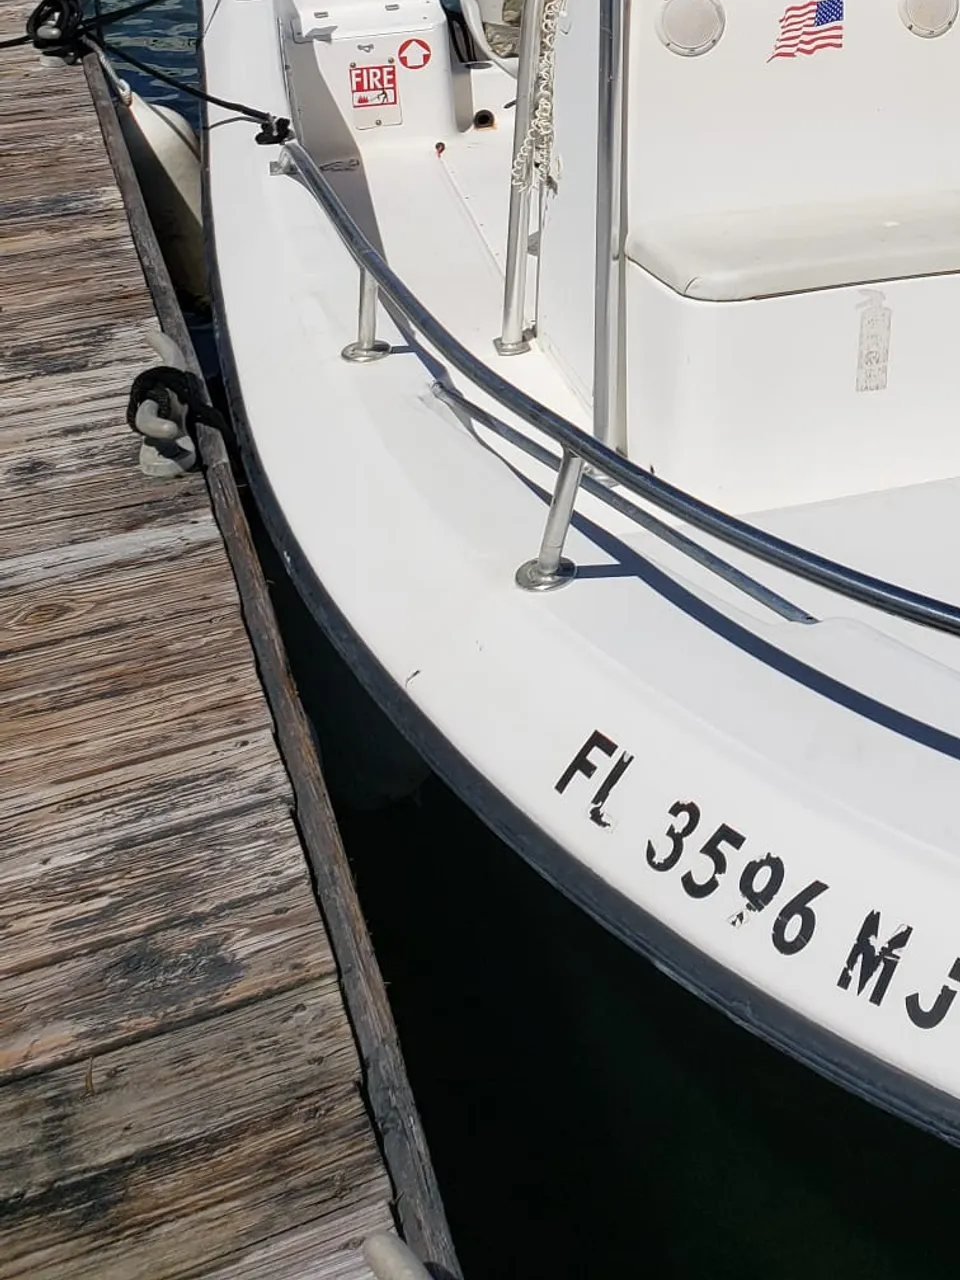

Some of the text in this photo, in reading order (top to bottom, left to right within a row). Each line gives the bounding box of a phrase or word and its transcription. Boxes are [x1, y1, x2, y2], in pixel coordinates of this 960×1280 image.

[351, 67, 394, 91] FIRE
[554, 729, 635, 831] FL
[646, 798, 830, 956] 3596
